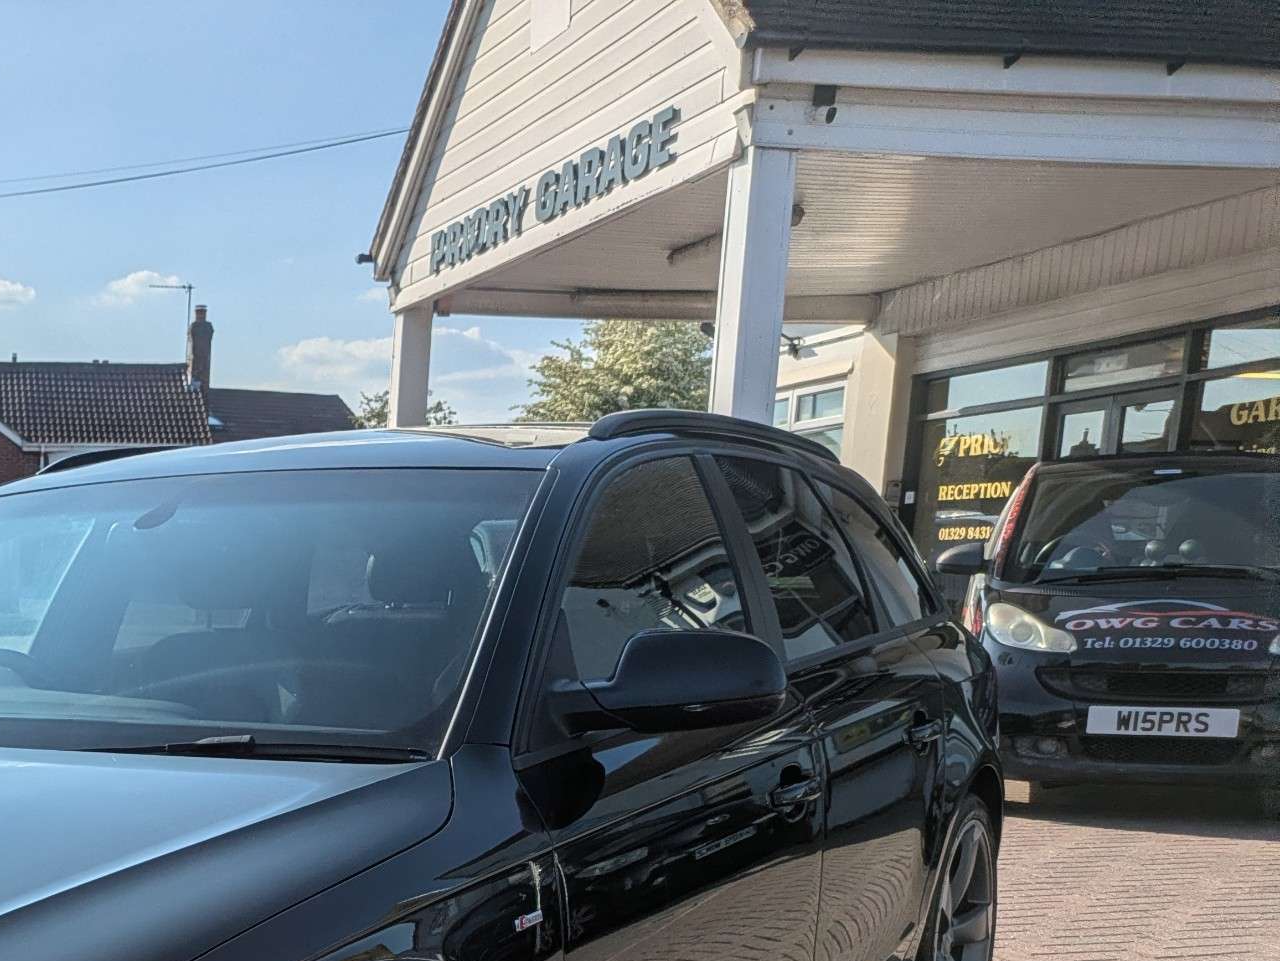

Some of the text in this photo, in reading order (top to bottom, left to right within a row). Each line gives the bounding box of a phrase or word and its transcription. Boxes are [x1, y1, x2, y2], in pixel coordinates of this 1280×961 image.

[430, 104, 681, 275] PRIORY GARAGE
[938, 481, 1012, 500] RECEPTION
[938, 527, 966, 540] 01329
[1065, 617, 1279, 631] OWG CARS
[1084, 637, 1258, 650] Tel: 01329 600380
